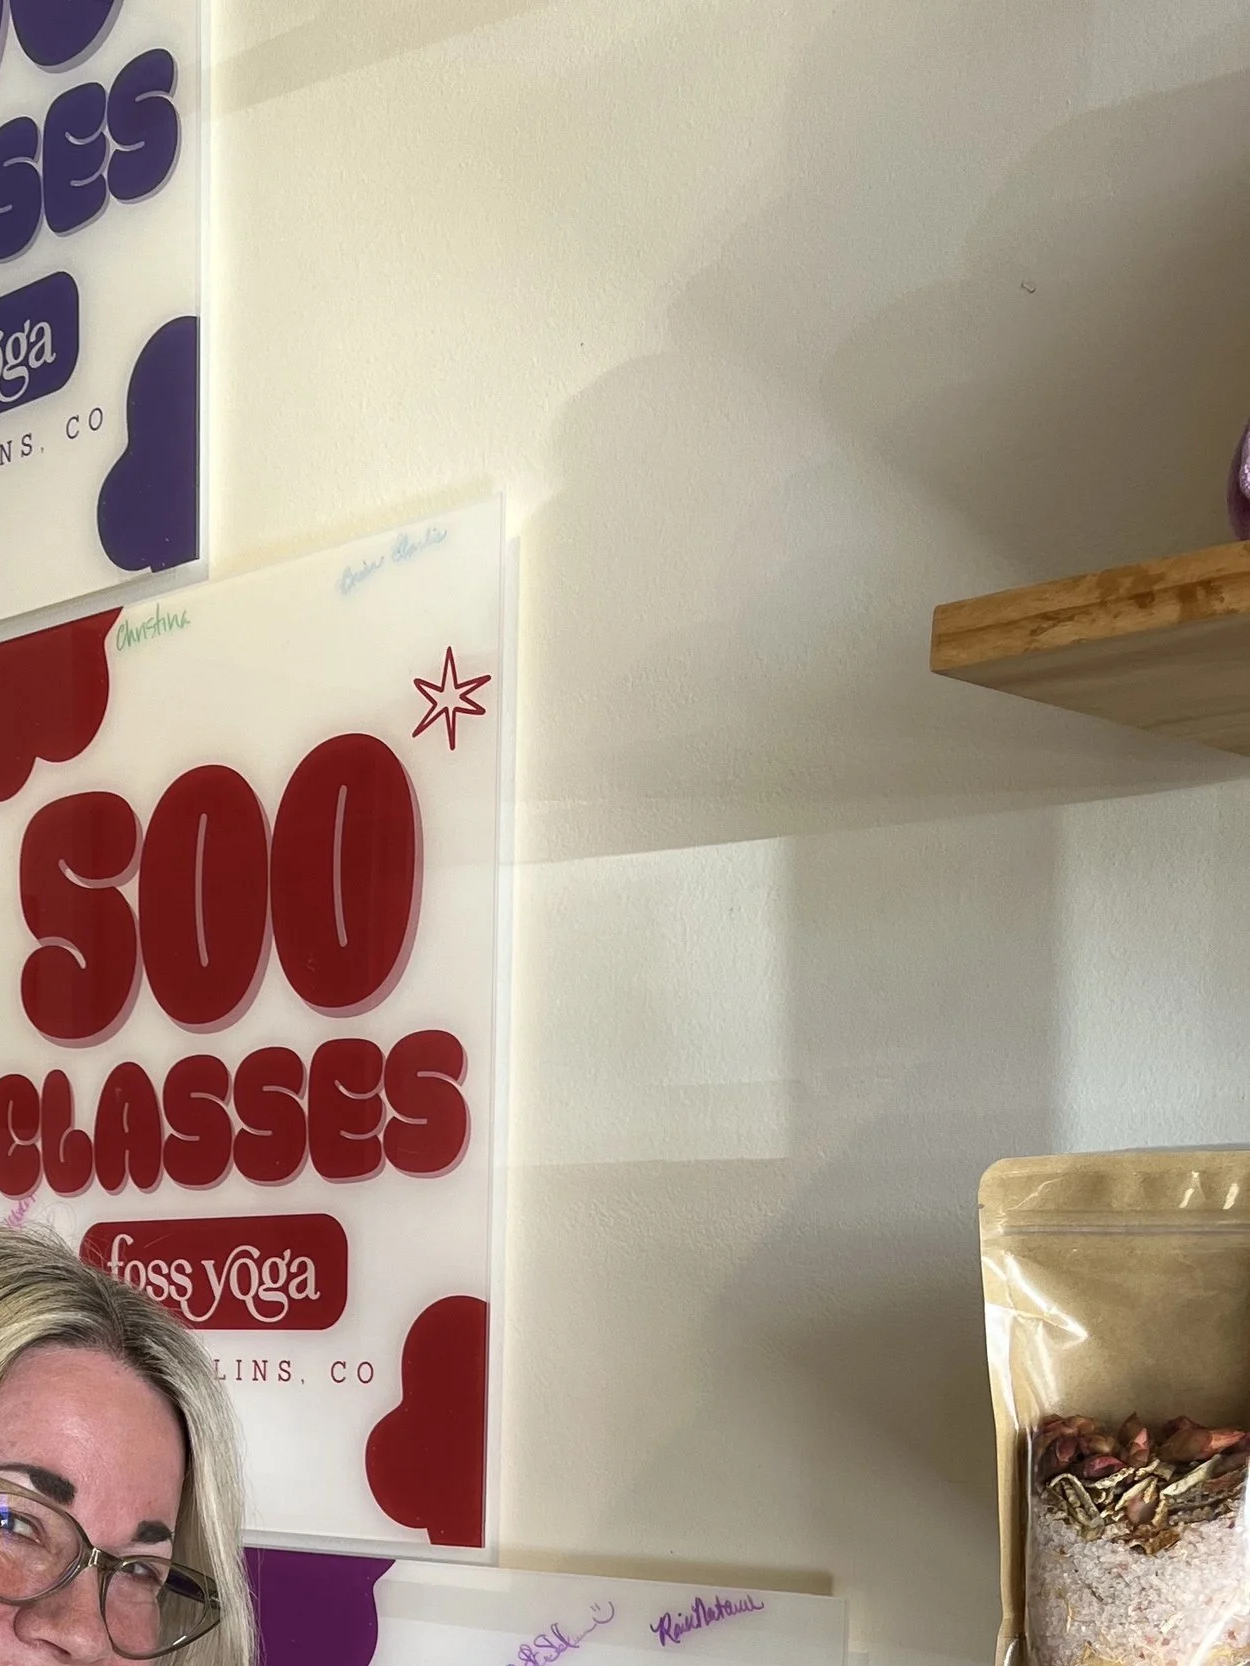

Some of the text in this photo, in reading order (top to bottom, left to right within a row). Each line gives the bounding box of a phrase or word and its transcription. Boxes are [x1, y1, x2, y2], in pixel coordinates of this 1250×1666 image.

[65, 407, 103, 439] CO
[116, 603, 191, 651] Christina
[19, 733, 424, 1048] 500
[107, 1233, 320, 1323] foss yoga
[213, 1359, 374, 1384] LINS, CO
